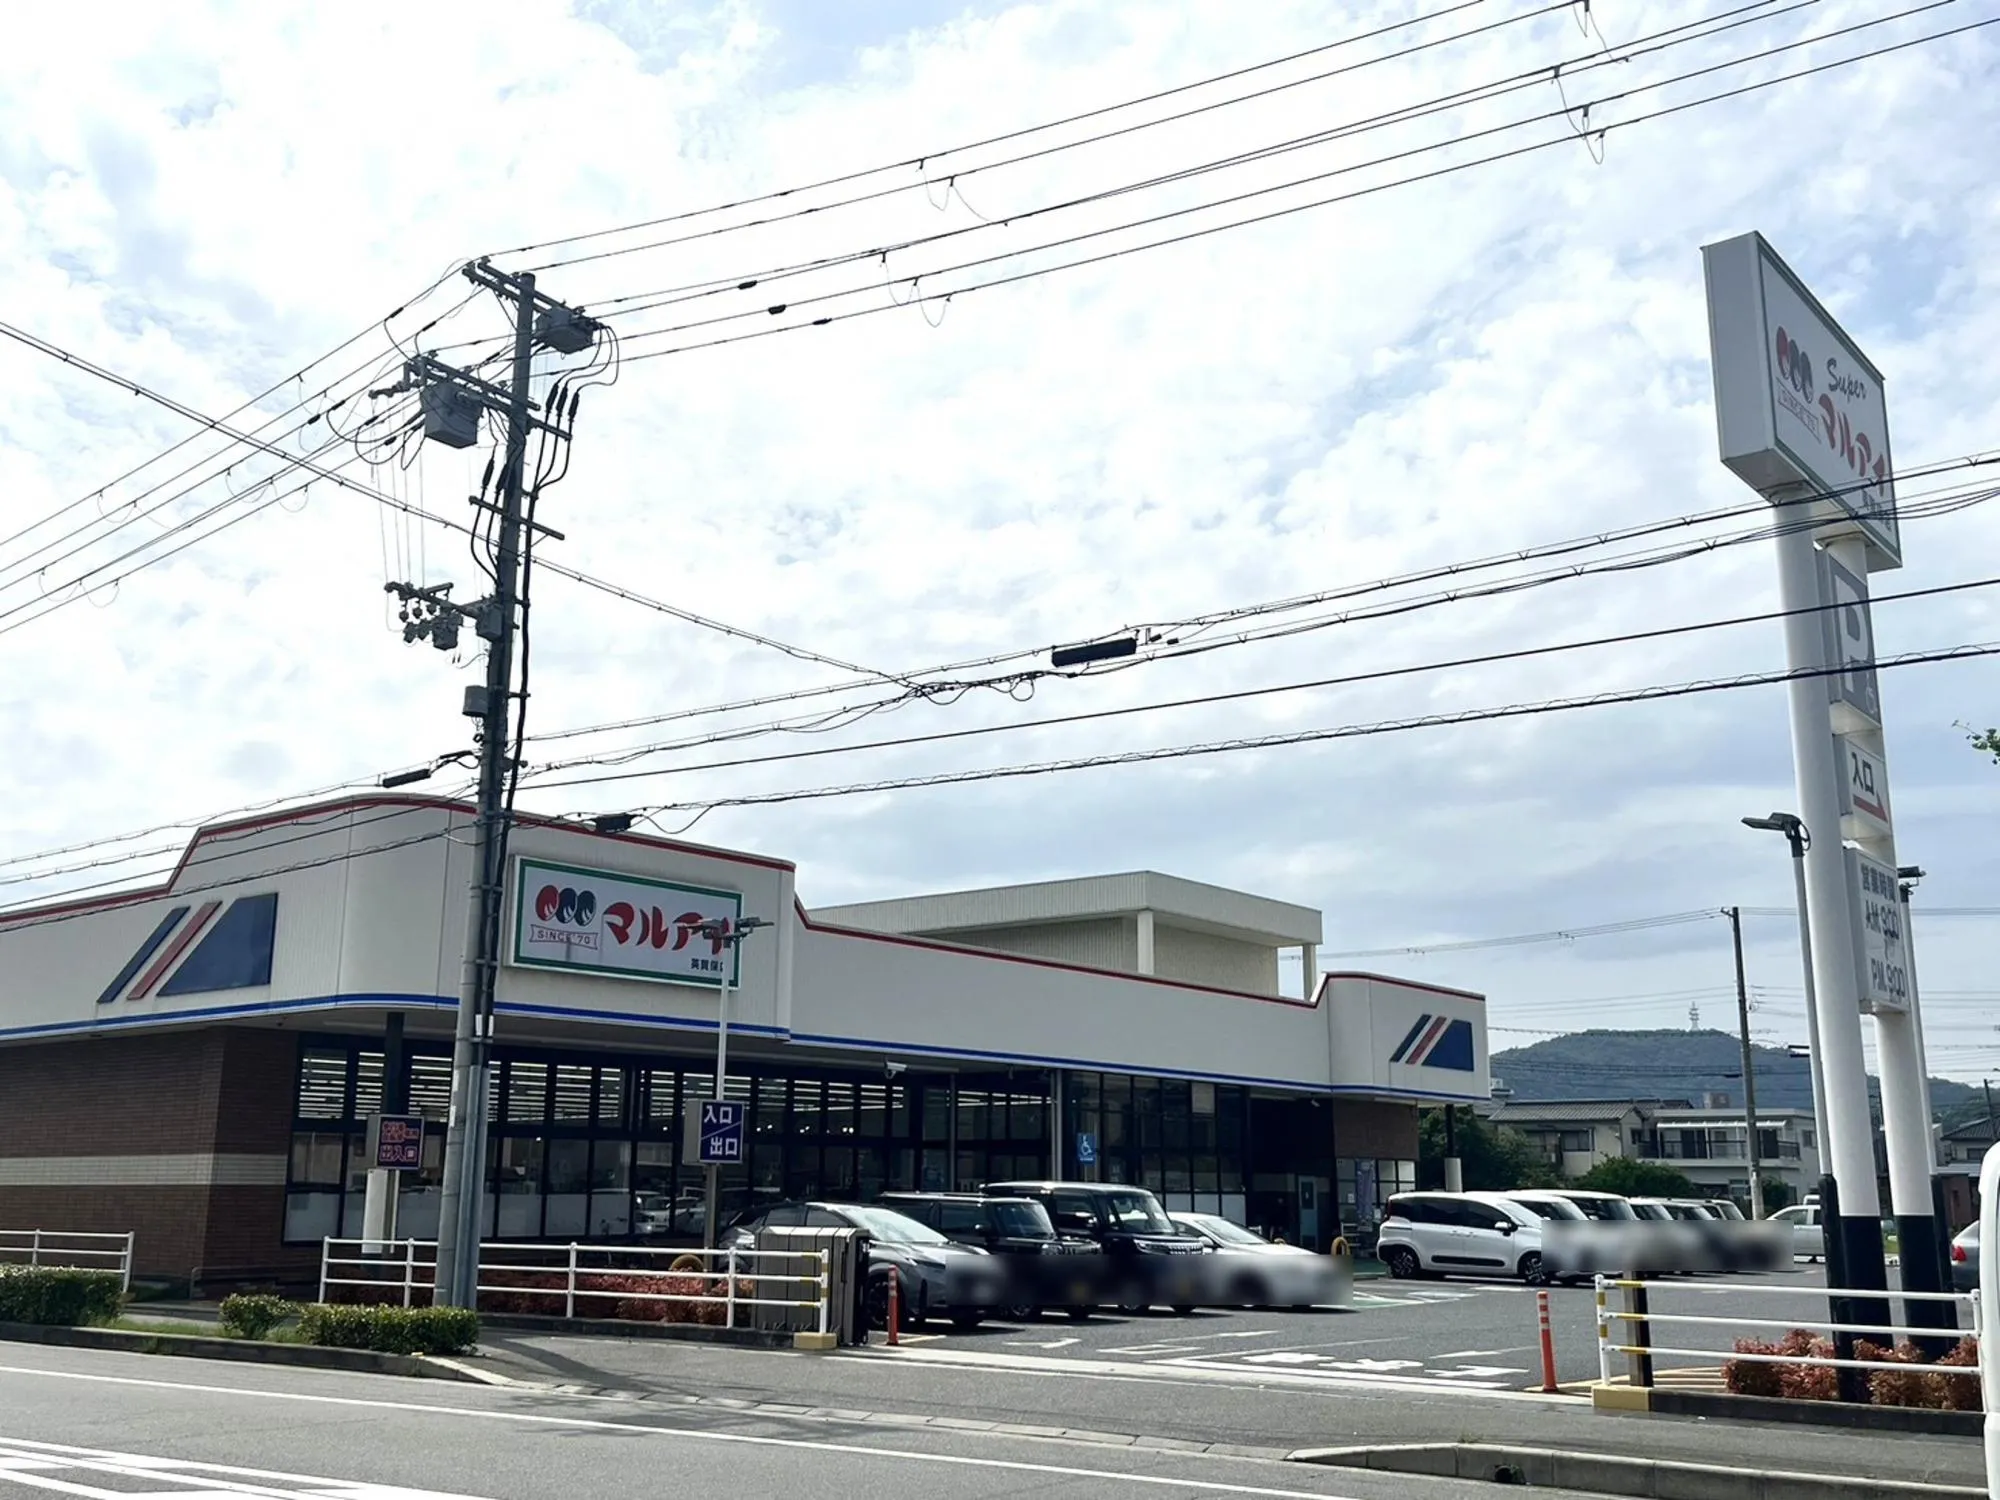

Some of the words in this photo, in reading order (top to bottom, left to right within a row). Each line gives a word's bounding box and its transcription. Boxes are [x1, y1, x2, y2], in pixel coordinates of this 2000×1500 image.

[1826, 357, 1867, 402] Super
[1835, 574, 1870, 693] P
[1851, 751, 1875, 795] 入口
[537, 930, 571, 942] SINCE
[703, 1104, 733, 1124] 入口
[379, 1145, 418, 1162] 出入口
[709, 1136, 738, 1156] 出口
